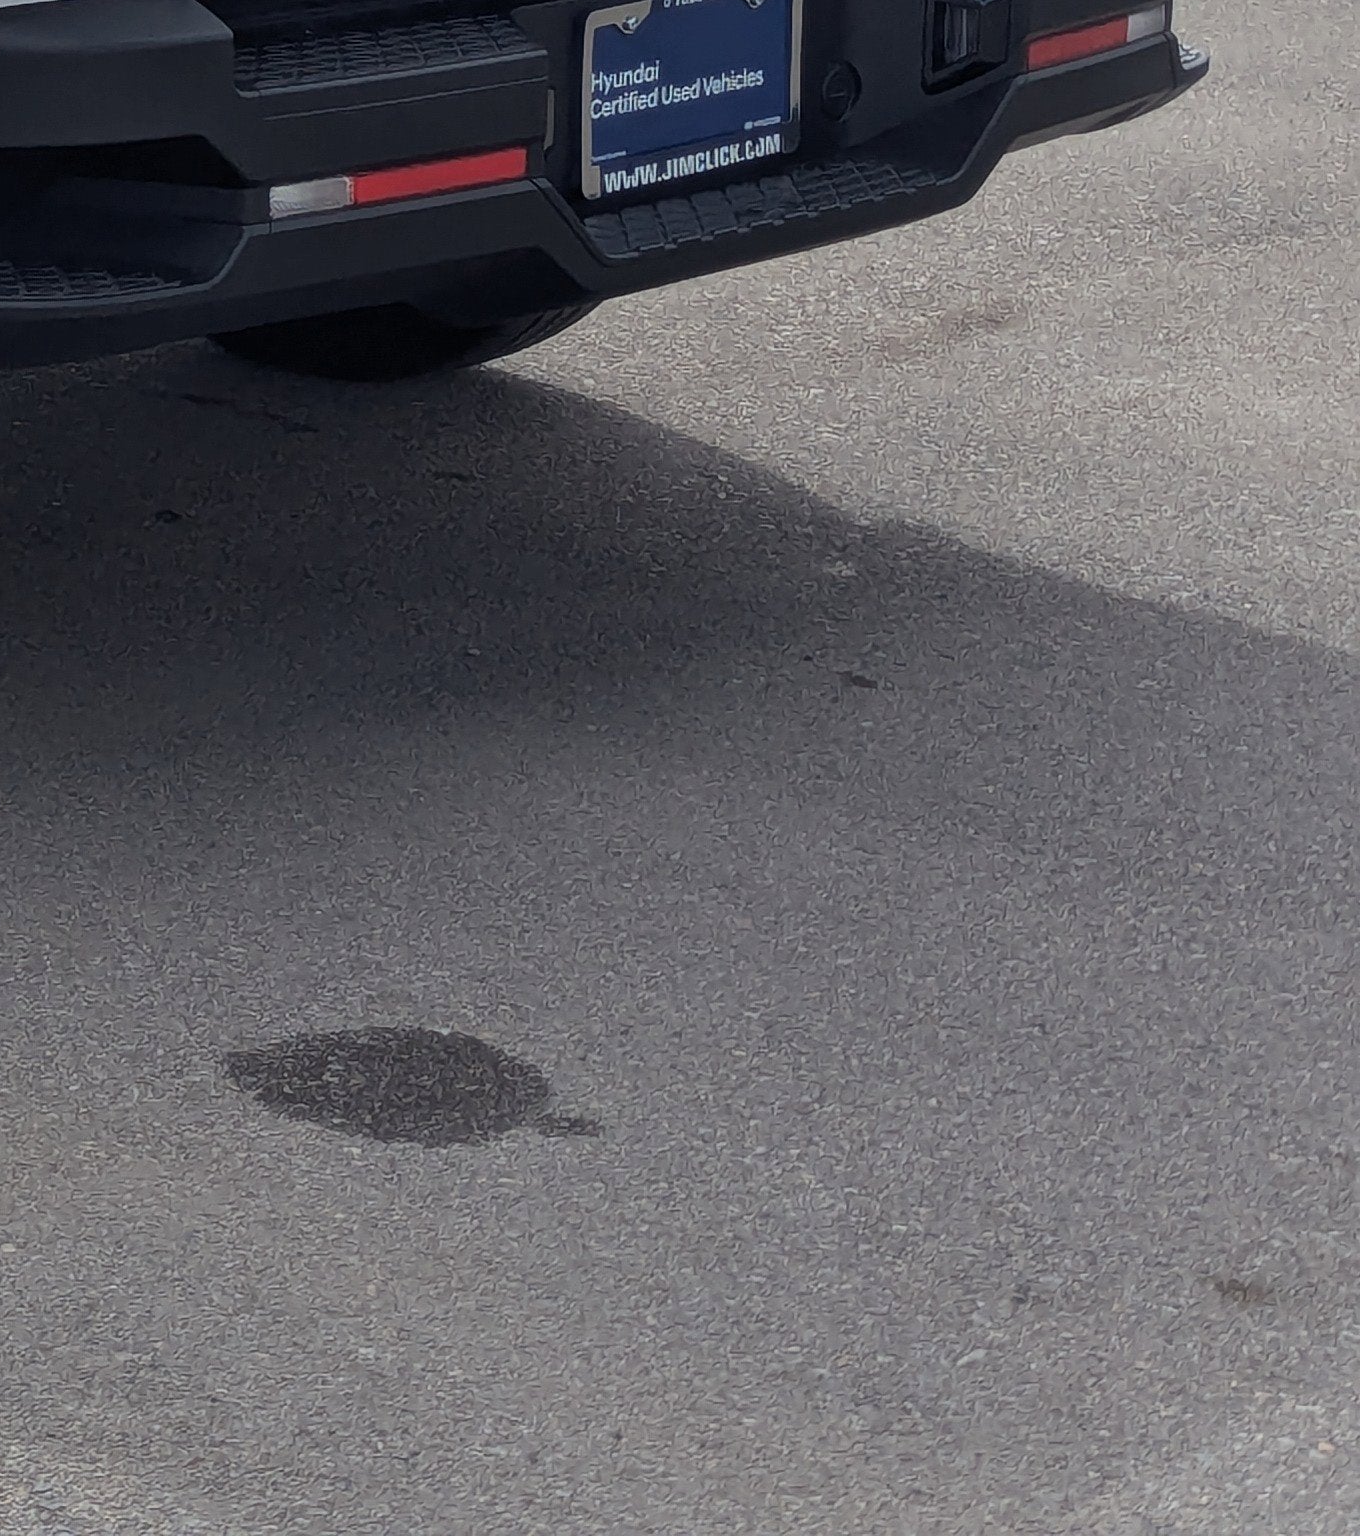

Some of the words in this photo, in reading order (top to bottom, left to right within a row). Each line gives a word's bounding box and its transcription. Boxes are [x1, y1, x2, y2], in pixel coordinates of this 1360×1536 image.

[590, 87, 658, 119] Certified
[661, 77, 701, 106] Used
[702, 67, 764, 97] Vehicles
[591, 60, 660, 95] Hyundai
[604, 134, 781, 193] WWW.JIMCLICK.COM
